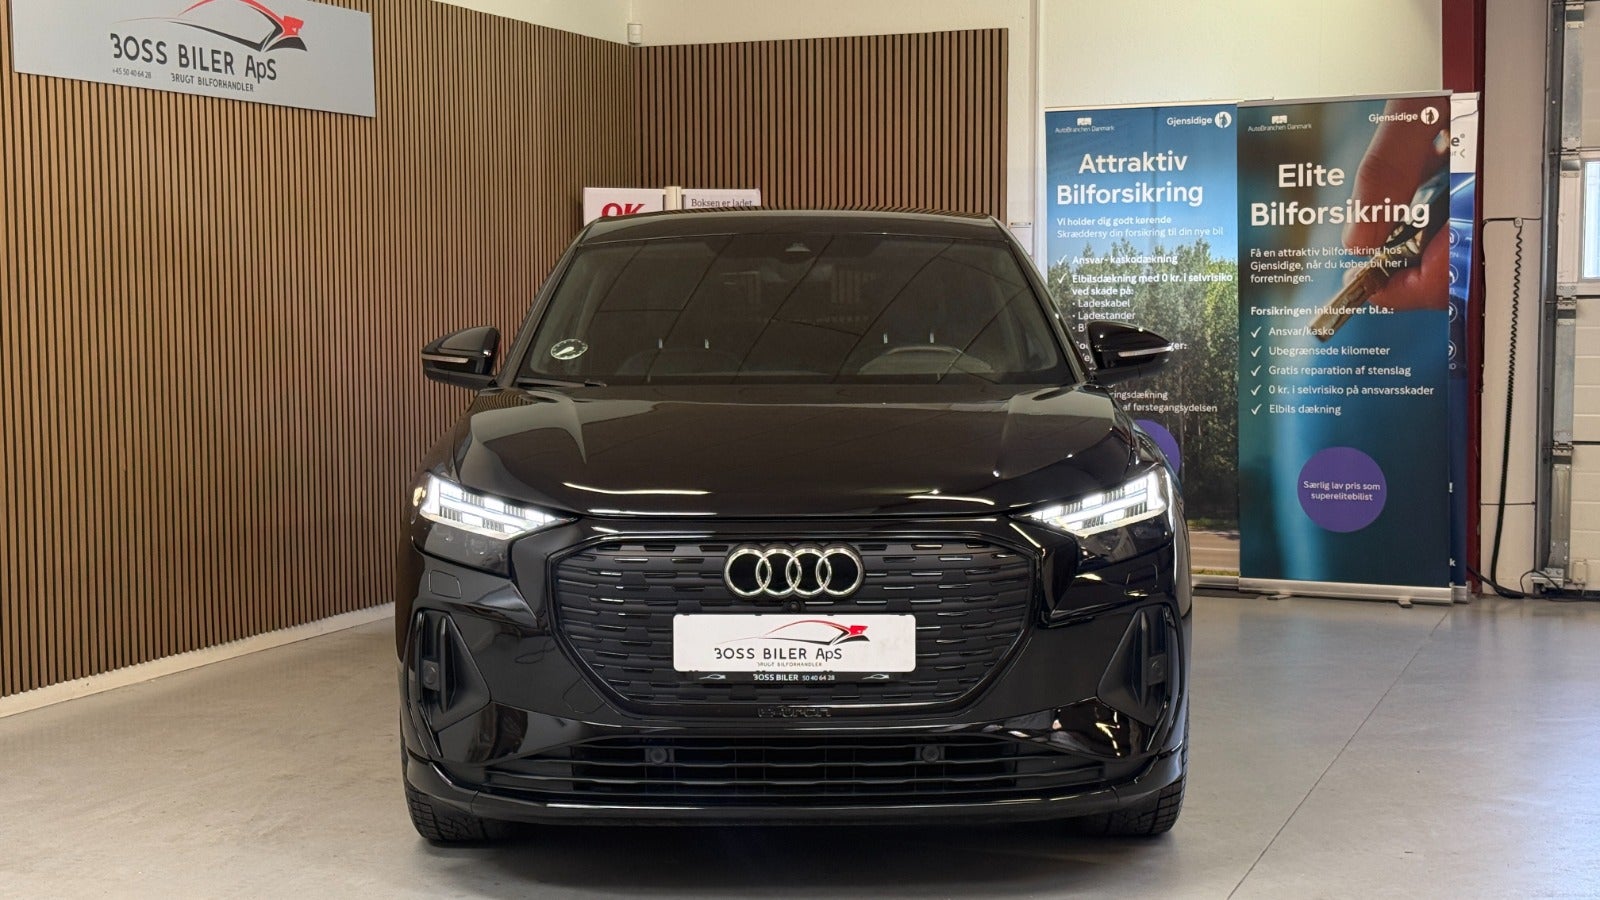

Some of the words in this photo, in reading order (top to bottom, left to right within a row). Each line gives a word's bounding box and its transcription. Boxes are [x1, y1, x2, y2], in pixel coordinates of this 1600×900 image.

[178, 44, 235, 76] BILER
[245, 54, 277, 84] ApS
[198, 76, 254, 92] BILFORHANDLER
[1166, 116, 1212, 128] Gjensidige
[1368, 112, 1418, 125] Gjensidige
[1078, 150, 1188, 174] Attraktiv
[1278, 162, 1345, 188] Elite
[1057, 181, 1203, 207] Bilforsikring
[691, 198, 720, 207] Boksen
[1250, 198, 1430, 228] Bilforsikring
[1057, 218, 1066, 226] Vi
[1067, 217, 1096, 226] holder
[1097, 216, 1110, 226] dig
[1113, 216, 1134, 226] godt
[1135, 216, 1172, 224] kørende
[1057, 230, 1107, 240] Skræddersy
[1109, 229, 1123, 237] din
[1125, 228, 1166, 238] forsikring
[1168, 228, 1177, 236] til
[1178, 227, 1192, 236] din
[1194, 228, 1210, 237] nye
[1212, 226, 1224, 236] bil
[1250, 248, 1262, 258] Få
[1278, 248, 1320, 257] attraktiv
[1322, 246, 1381, 258] bilforsikring
[1383, 246, 1402, 255] hos
[1110, 254, 1178, 265] kaskodækning
[1250, 260, 1304, 272] Gjensidige,
[1306, 260, 1322, 269] når
[1324, 260, 1337, 268] du
[1340, 259, 1368, 268] køber
[1370, 258, 1382, 268] bil
[1384, 258, 1402, 268] her
[1404, 259, 1408, 267] i
[1072, 274, 1136, 284] Elbilsdækning
[1139, 274, 1160, 282] med
[1162, 274, 1168, 282] 0
[1170, 273, 1182, 282] kr.
[1188, 272, 1232, 282] selvrisiko
[1250, 272, 1314, 284] forretningen.
[1072, 287, 1089, 296] ved
[1091, 286, 1118, 295] skade
[1120, 286, 1134, 297] på:
[1078, 299, 1130, 308] Ladeskabel
[1078, 311, 1136, 320] Ladestander
[1250, 306, 1312, 316] Forsikringen
[1314, 306, 1366, 316] inkluderer
[1369, 305, 1394, 315] bl.a.:
[1268, 326, 1334, 337] Ansvar/kasko
[1268, 346, 1339, 358] Ubegrænsede
[1341, 346, 1390, 356] kilometer
[1268, 366, 1298, 375] Gratis
[1300, 366, 1353, 377] reparation
[1355, 366, 1366, 375] af
[1368, 366, 1412, 377] stenslag
[1110, 391, 1168, 400] ringsdækning
[1268, 385, 1276, 394] 0
[1278, 385, 1290, 394] kr.
[1298, 385, 1344, 394] selvrisiko
[1346, 384, 1358, 396] på
[1361, 386, 1434, 395] ansvarsskader
[1122, 402, 1131, 411] af
[1133, 403, 1218, 414] førstegangsydelsen
[1269, 404, 1296, 414] Elbils
[1298, 404, 1342, 416] dækning
[1303, 481, 1330, 490] Særlig
[1332, 482, 1344, 490] lav
[1346, 482, 1363, 491] pris
[1311, 492, 1372, 502] superelitebilist
[763, 648, 807, 660] BILER
[816, 648, 842, 662] ApS
